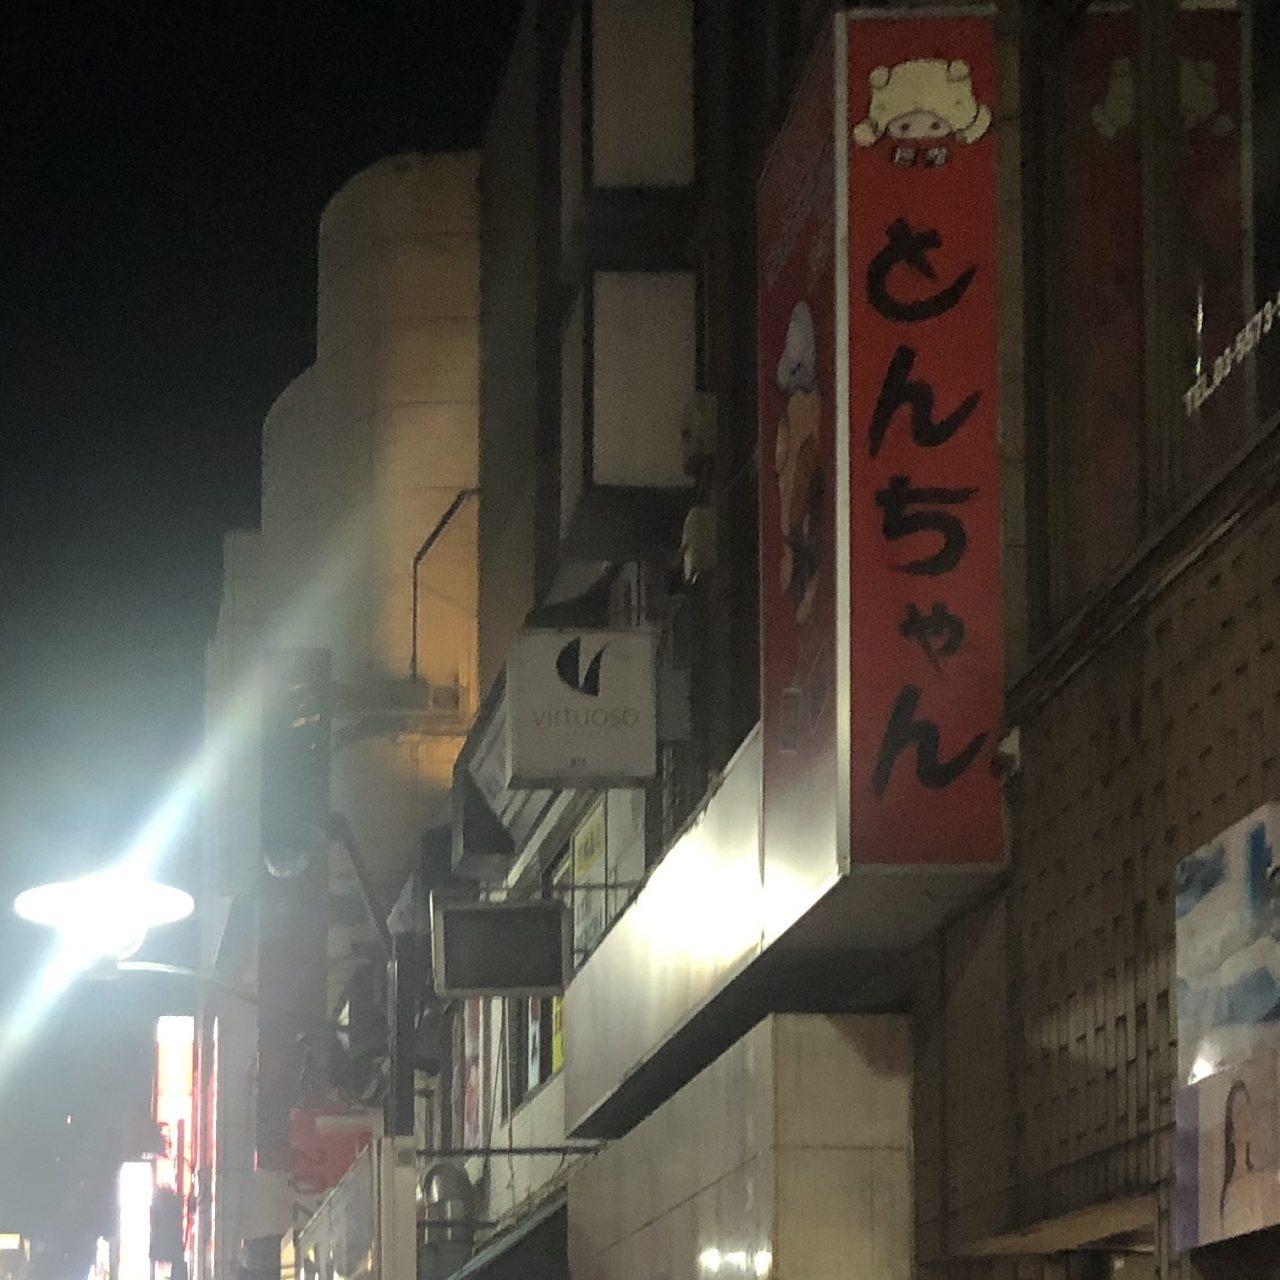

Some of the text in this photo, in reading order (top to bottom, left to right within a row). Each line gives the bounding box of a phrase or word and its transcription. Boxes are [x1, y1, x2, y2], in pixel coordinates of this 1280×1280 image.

[868, 216, 988, 798] とんちゃん
[532, 706, 640, 728] virtuoso
